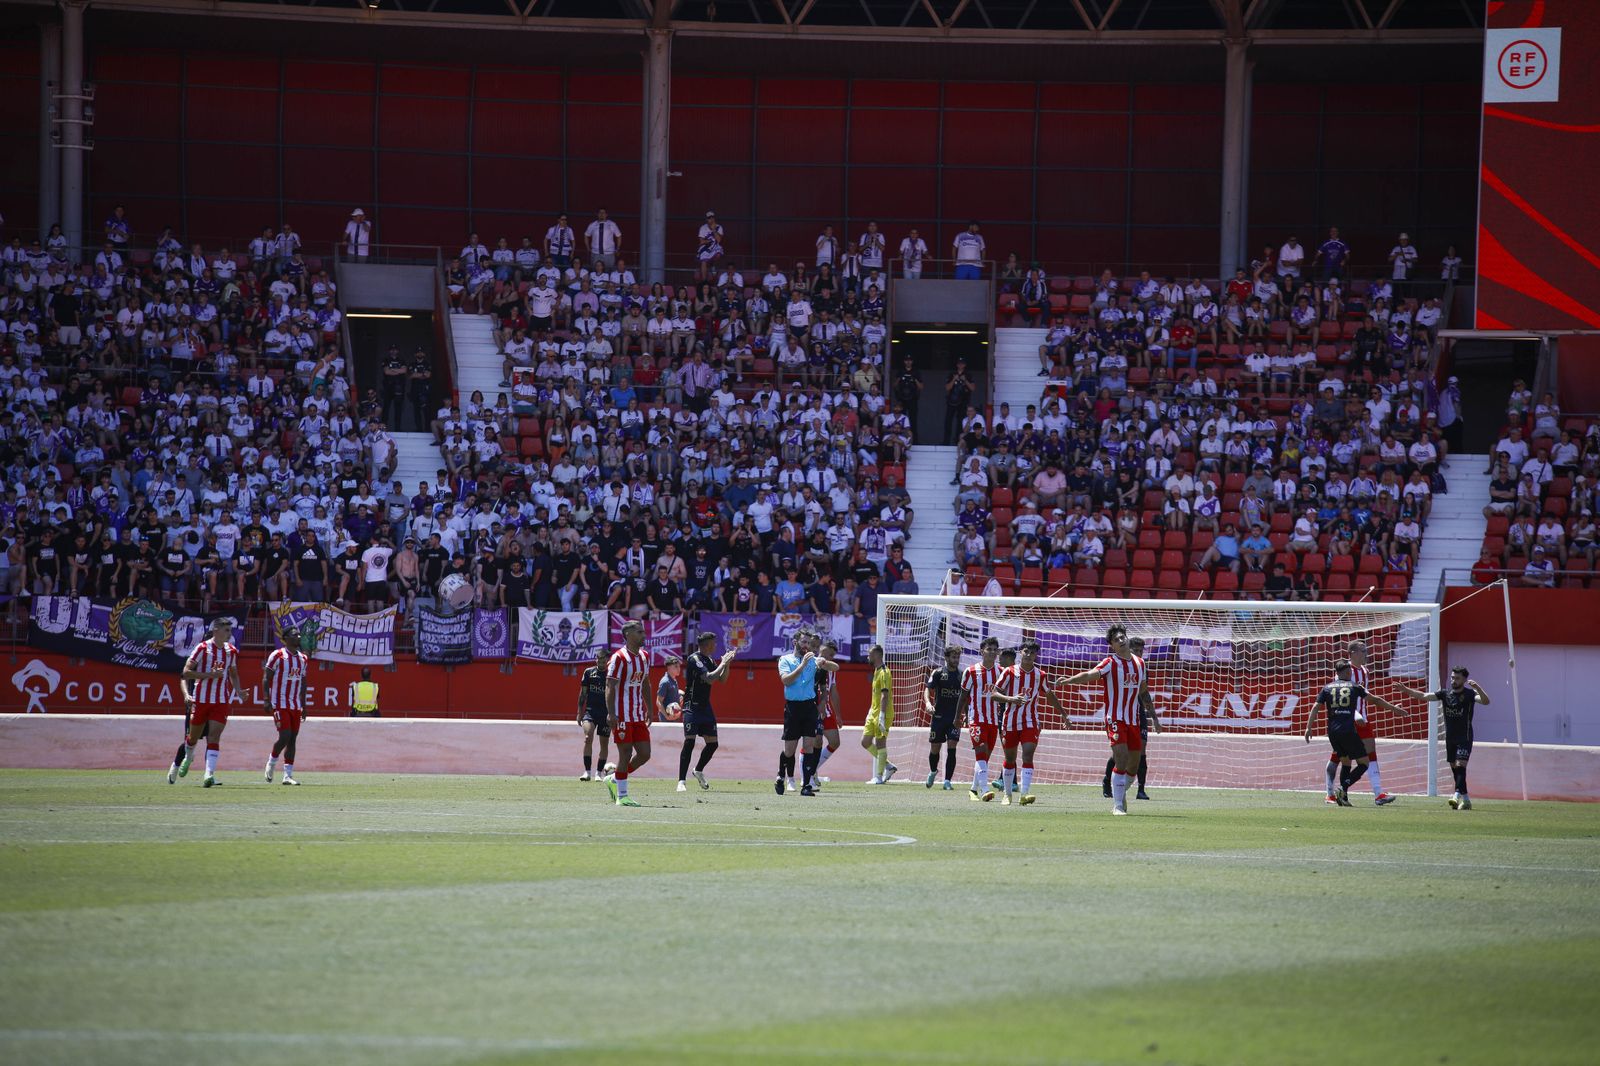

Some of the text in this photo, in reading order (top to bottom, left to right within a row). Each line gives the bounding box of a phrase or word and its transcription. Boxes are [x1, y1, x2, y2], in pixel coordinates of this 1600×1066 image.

[478, 648, 505, 657] PRESENTE
[521, 642, 572, 660] YOUNG
[65, 681, 173, 704] COSTA
[1330, 687, 1351, 708] 18
[685, 723, 692, 732] 9
[970, 726, 981, 737] 23
